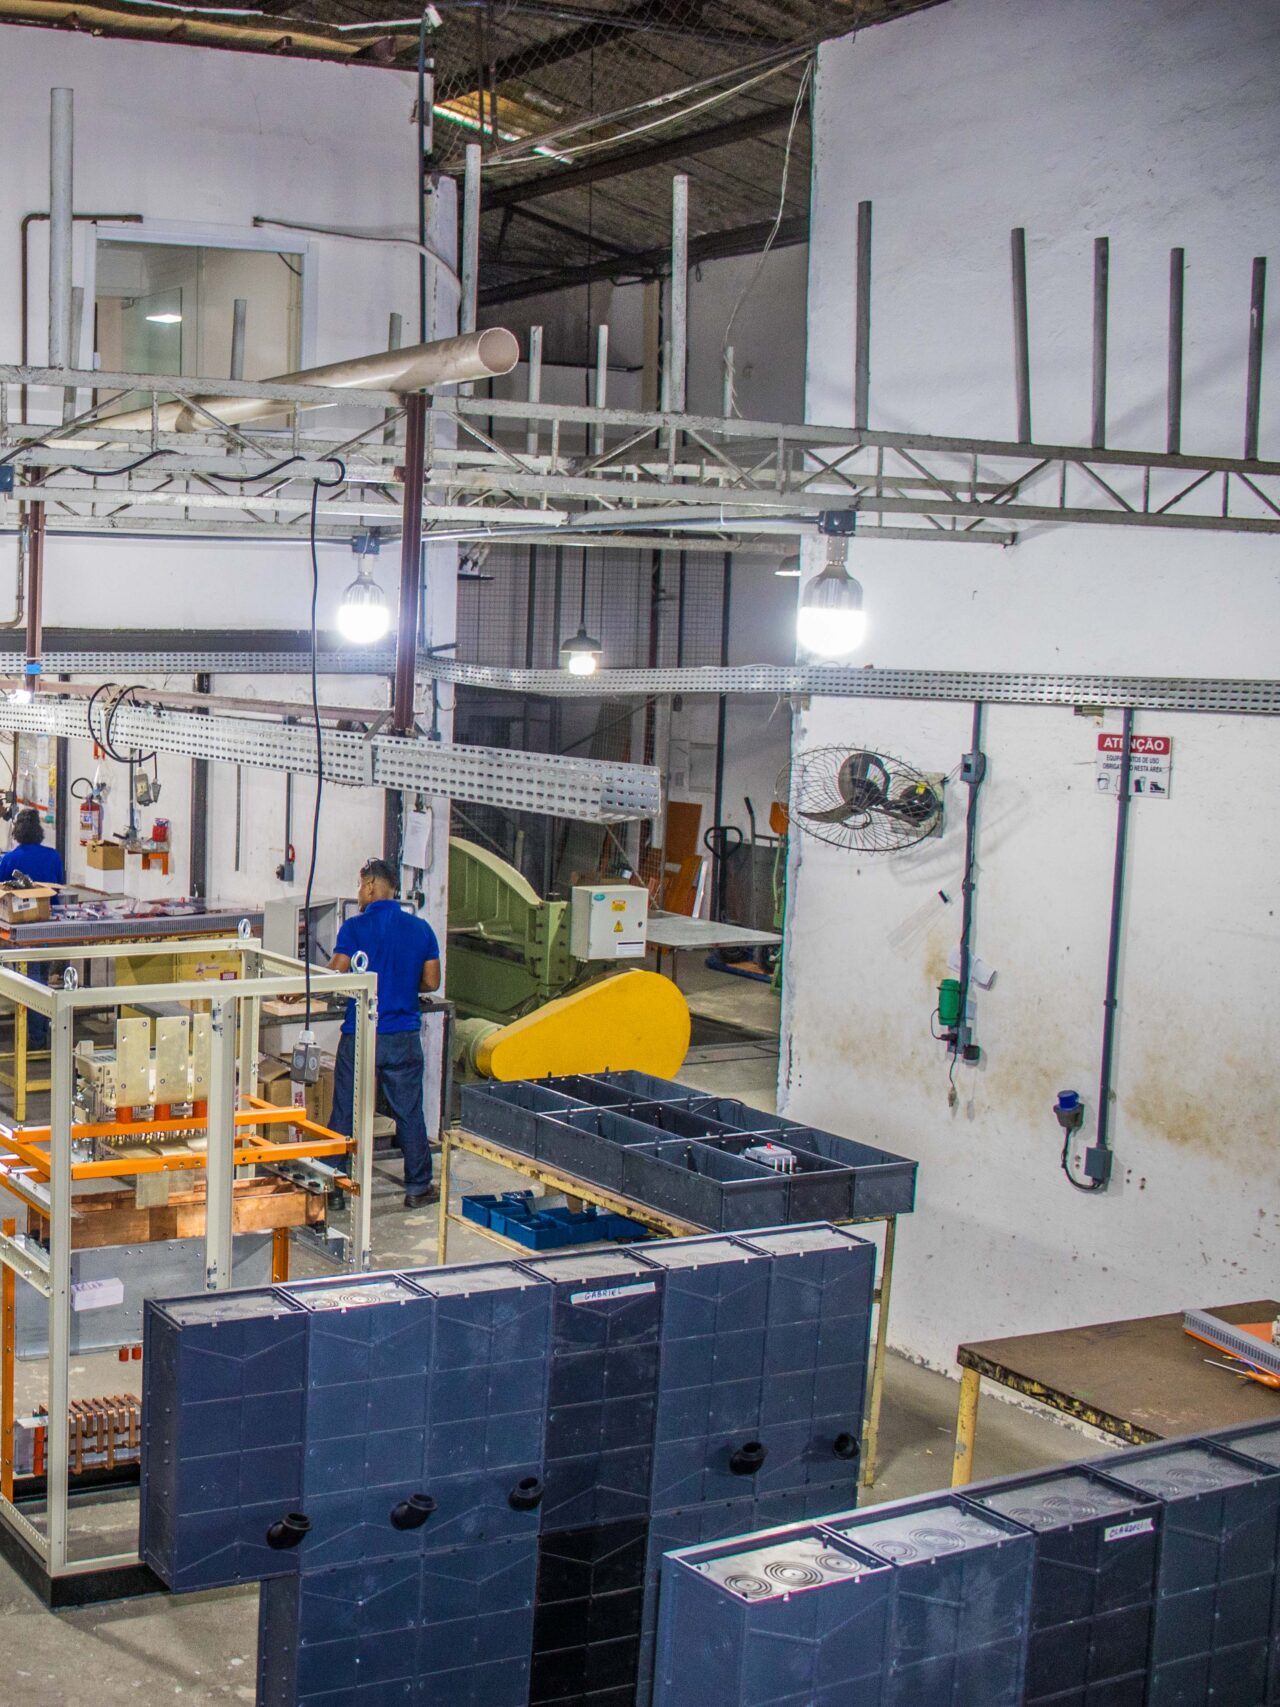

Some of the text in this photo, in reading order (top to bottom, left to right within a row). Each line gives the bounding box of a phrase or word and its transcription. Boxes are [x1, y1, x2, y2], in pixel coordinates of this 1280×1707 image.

[1106, 754, 1141, 763] EQUIPTOS
[1103, 763, 1133, 771] OBRIGAO
[584, 1287, 622, 1300] GABRIEL
